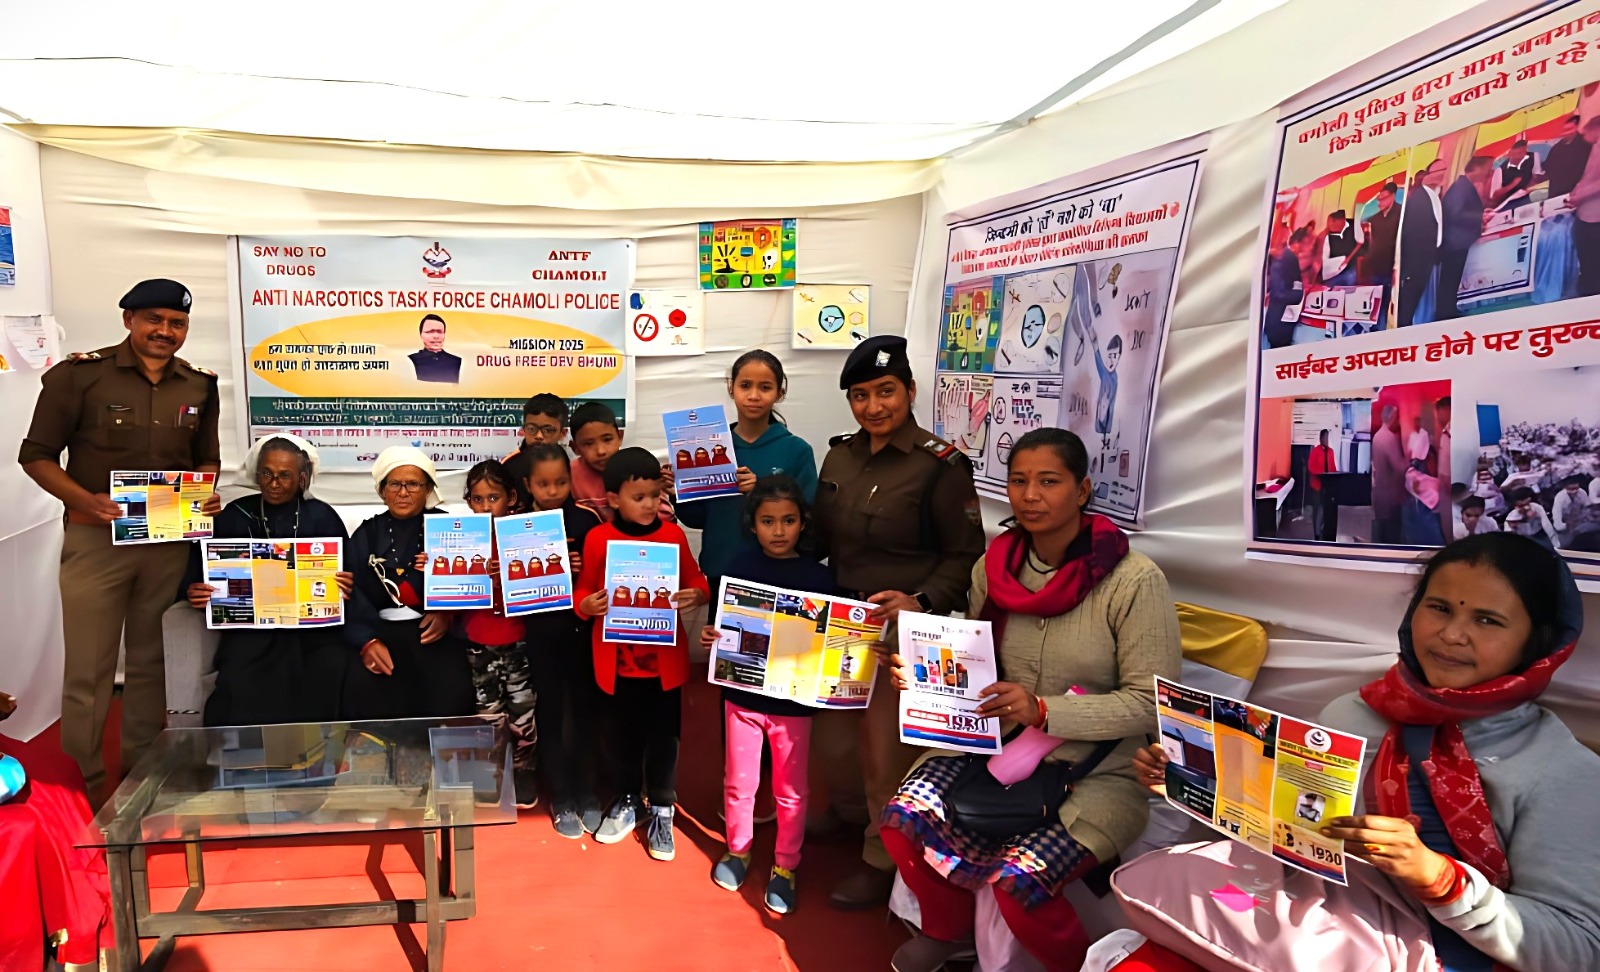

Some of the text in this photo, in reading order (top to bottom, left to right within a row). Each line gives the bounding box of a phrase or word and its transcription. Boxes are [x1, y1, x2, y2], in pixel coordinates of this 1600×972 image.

[1516, 57, 1551, 82] जा
[1556, 41, 1590, 66] रहे
[254, 246, 326, 258] SAY NO TO
[252, 289, 620, 310] ANTI NARCOTICS TASK FORCE CHAMOLI POLICE
[509, 339, 585, 351] MISSION 2025
[477, 355, 511, 367] DRUG
[516, 355, 546, 367] FREE
[551, 356, 574, 367] DEV
[1275, 353, 1340, 380] साईबर
[1343, 345, 1419, 372] अपराध
[1424, 330, 1477, 362] होने
[1482, 329, 1524, 352] पर
